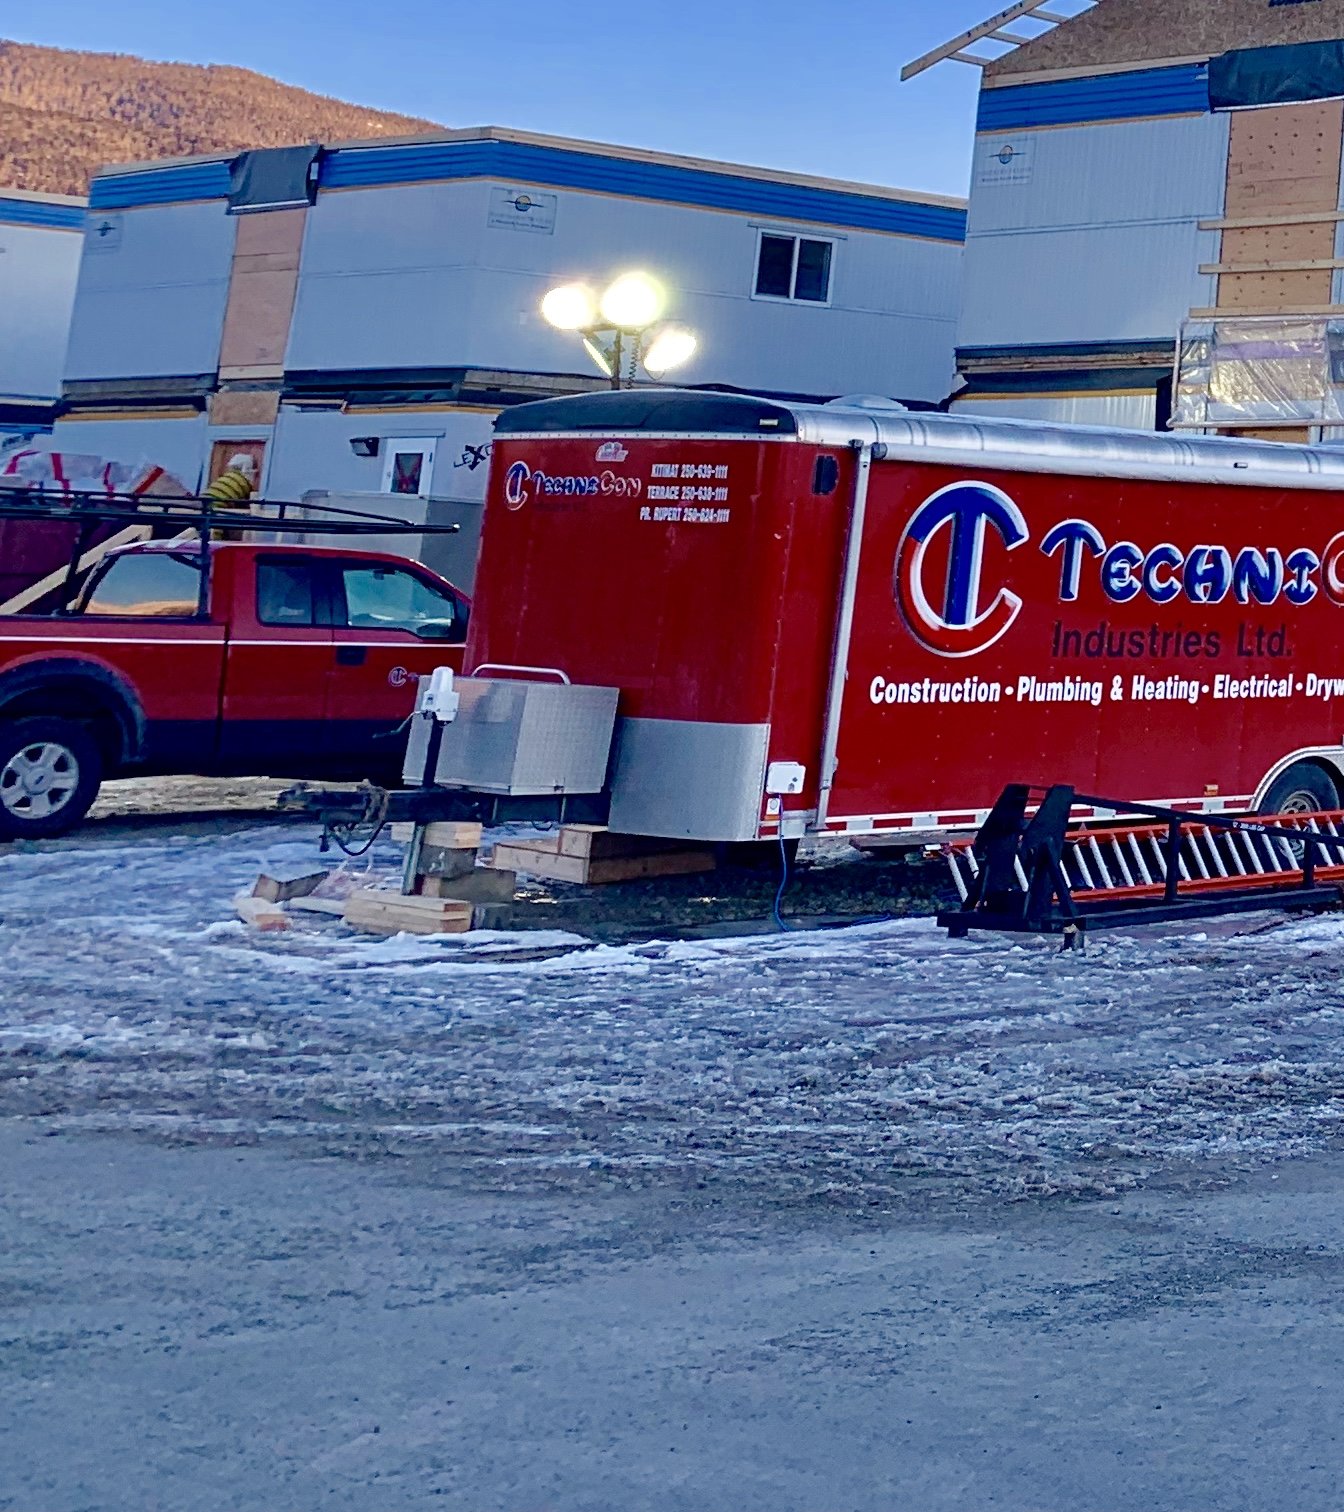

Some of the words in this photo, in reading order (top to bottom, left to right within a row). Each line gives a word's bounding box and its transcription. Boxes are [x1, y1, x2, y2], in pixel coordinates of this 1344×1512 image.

[1052, 620, 1221, 659] Industries
[1236, 621, 1293, 658] Ltd.
[870, 676, 1001, 704] Construction
[1016, 676, 1103, 706] Plumbing
[1110, 675, 1123, 701] &
[1131, 674, 1200, 704] Heating
[1213, 674, 1293, 698] Electrical
